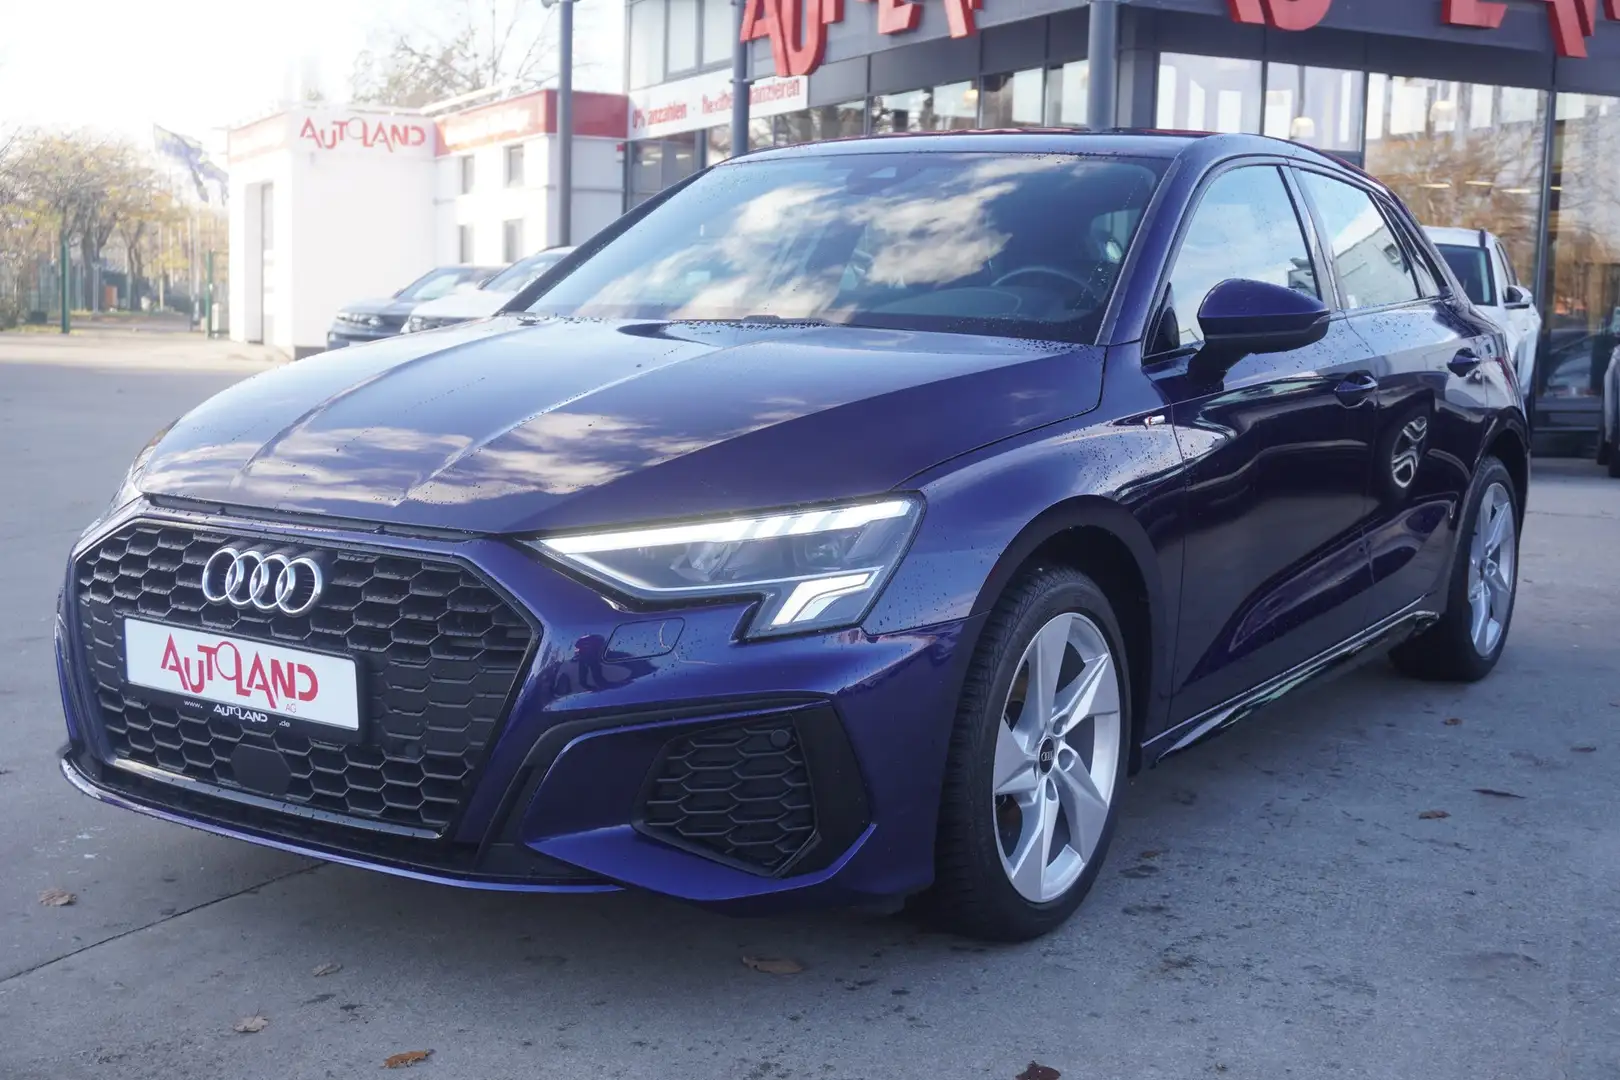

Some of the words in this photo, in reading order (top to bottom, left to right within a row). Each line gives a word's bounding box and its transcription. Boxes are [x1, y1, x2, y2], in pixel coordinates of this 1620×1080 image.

[300, 116, 426, 153] AUTOLAND
[160, 632, 319, 709] AUTOLAND
[213, 703, 269, 723] AUTOLAND
[285, 703, 297, 713] AG
